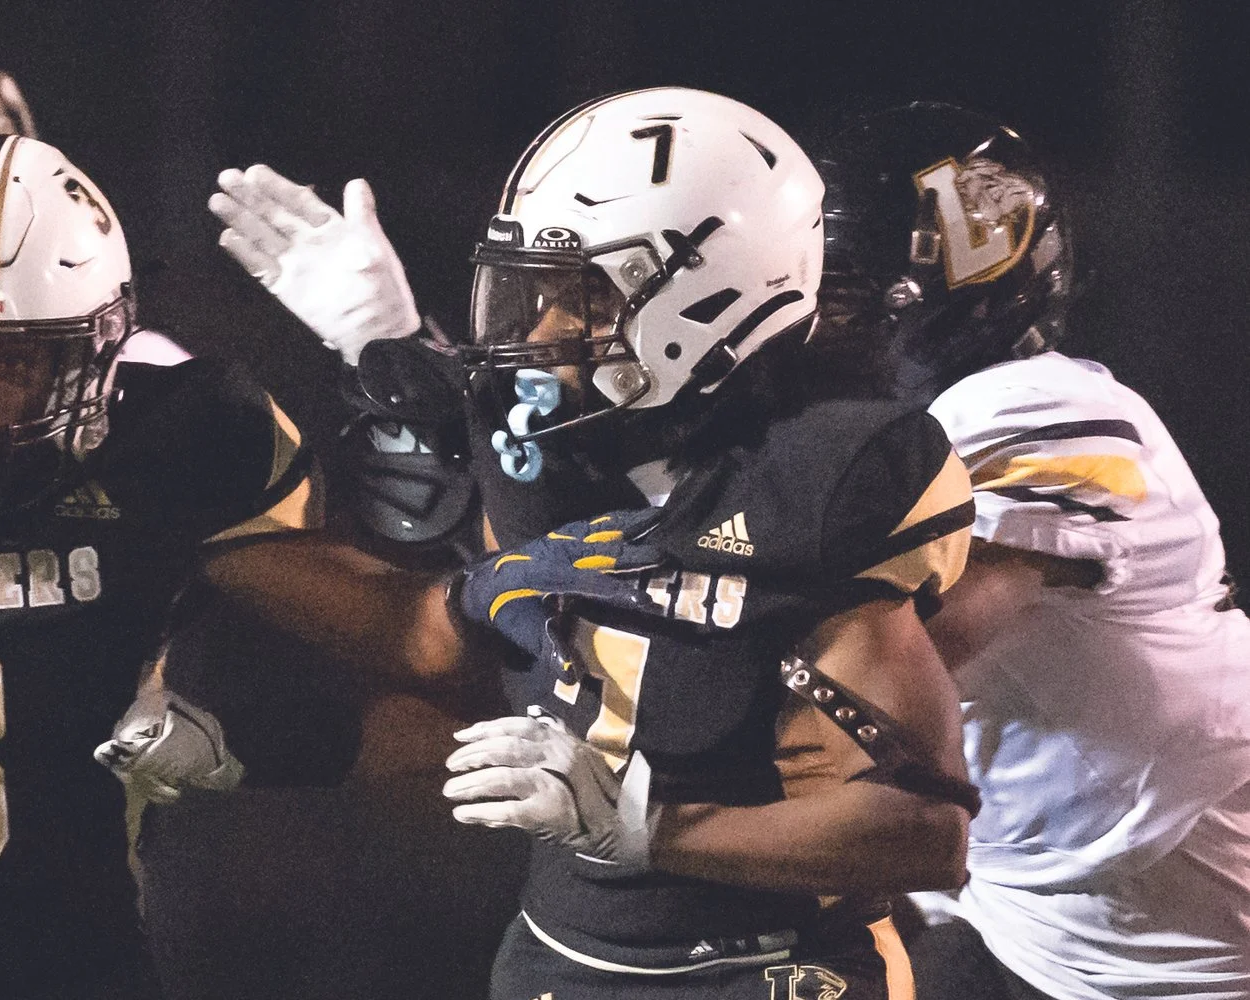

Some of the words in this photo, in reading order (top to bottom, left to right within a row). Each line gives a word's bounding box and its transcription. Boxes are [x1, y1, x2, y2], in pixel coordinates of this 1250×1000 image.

[630, 124, 675, 186] 7
[534, 240, 579, 248] OAKLEY
[697, 532, 755, 556] adidas
